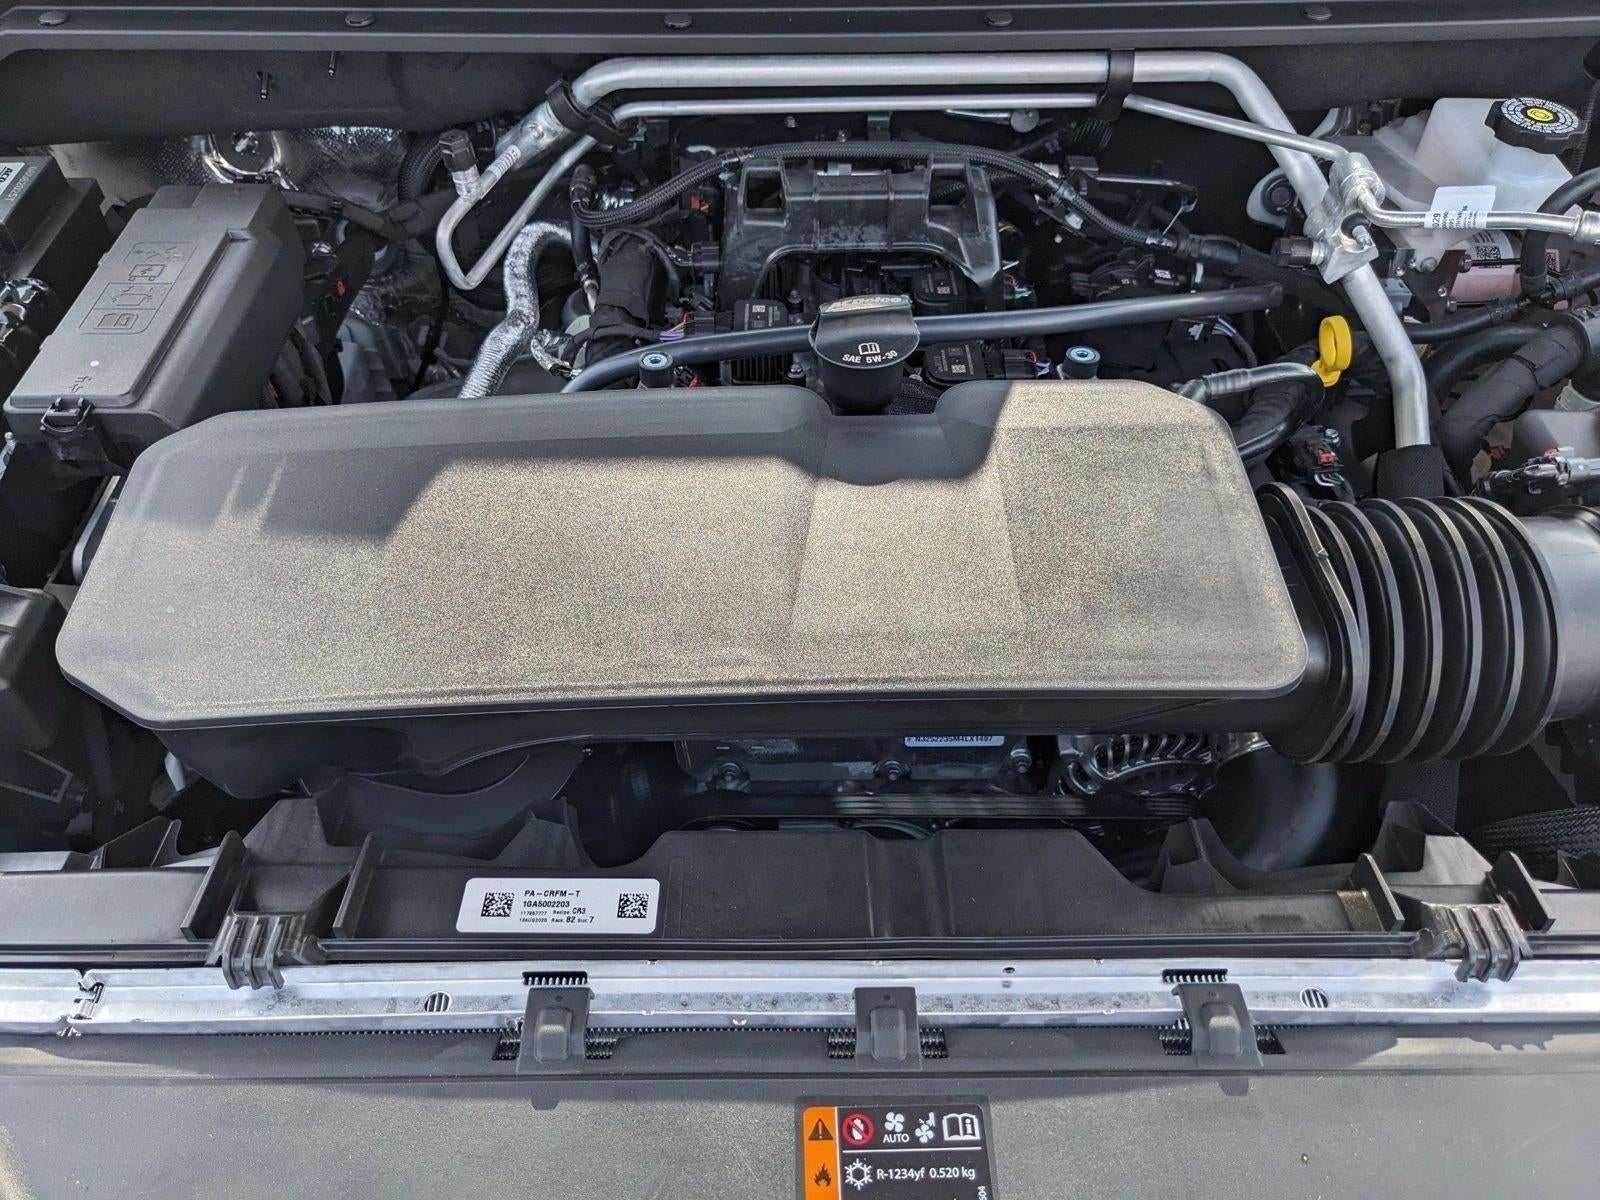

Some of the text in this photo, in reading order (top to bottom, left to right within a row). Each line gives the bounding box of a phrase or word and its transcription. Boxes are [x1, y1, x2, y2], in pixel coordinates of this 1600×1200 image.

[842, 350, 898, 364] SAE 5W-30
[883, 1134, 909, 1143] AUTO
[877, 1167, 976, 1181] R-1234yf 0.520 kg
